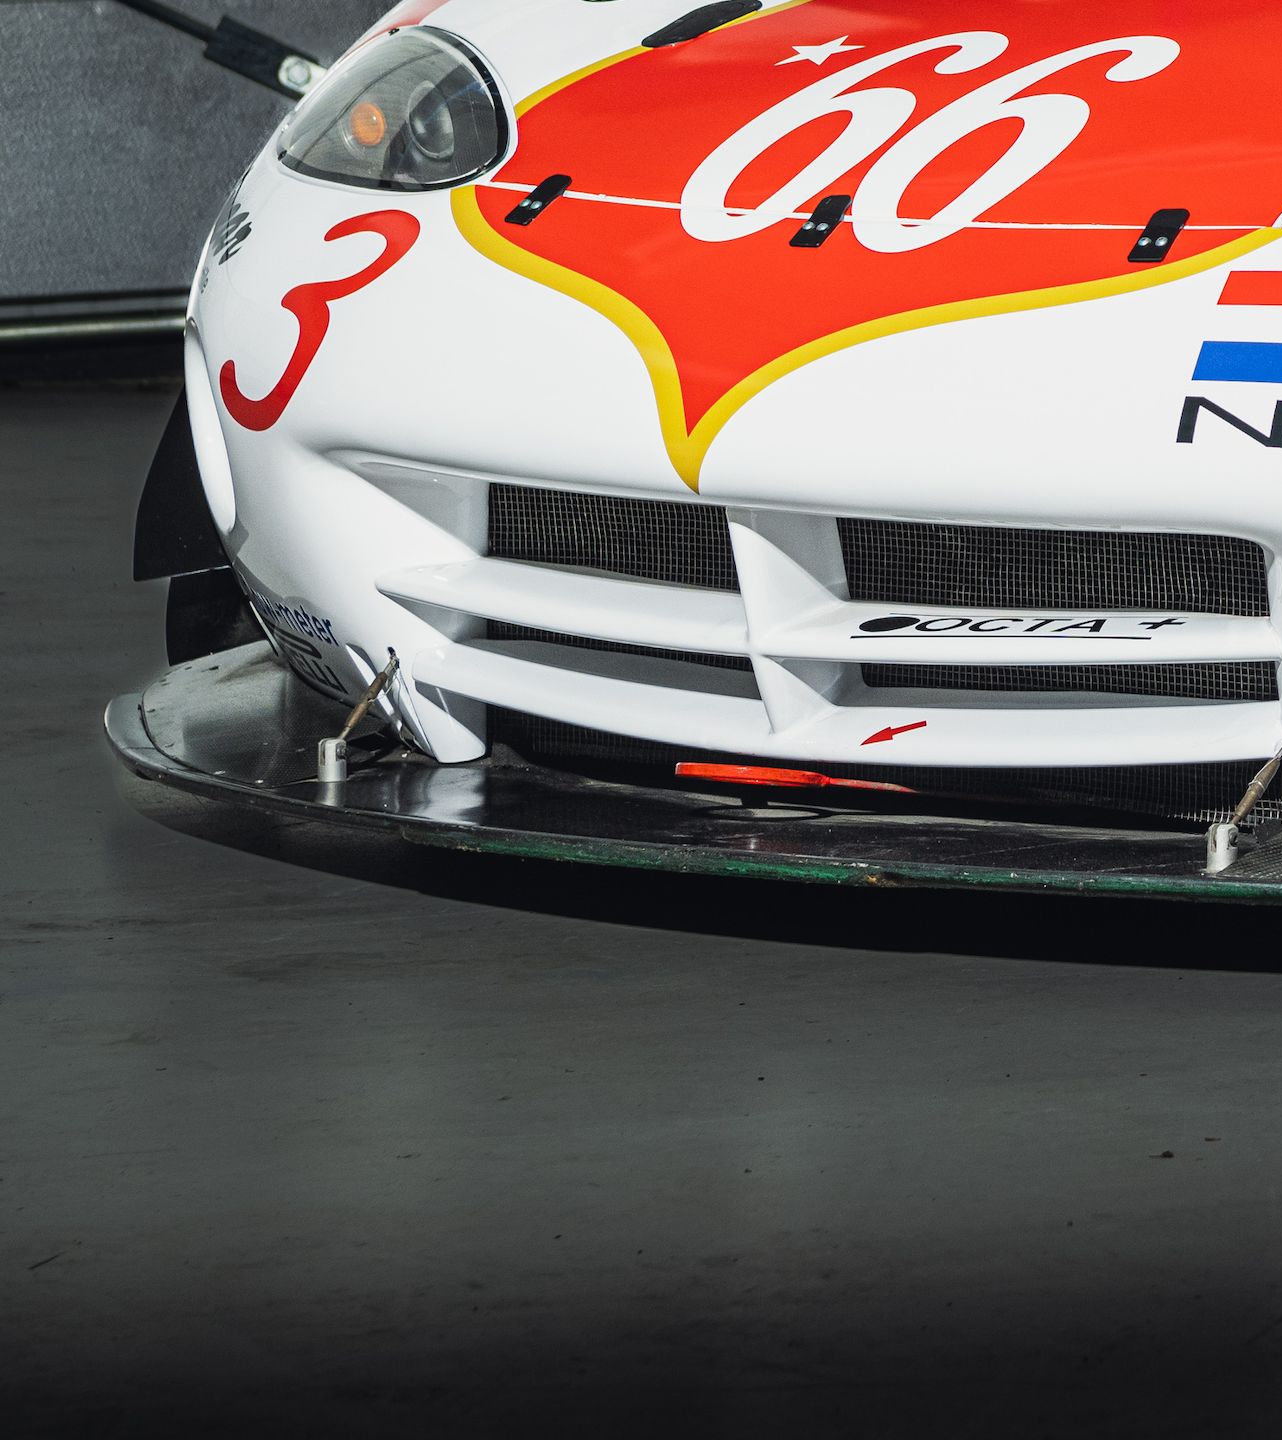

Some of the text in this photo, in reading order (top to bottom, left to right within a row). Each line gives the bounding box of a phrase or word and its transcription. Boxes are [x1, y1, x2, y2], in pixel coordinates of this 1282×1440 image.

[679, 29, 1181, 255] 66
[219, 209, 421, 433] 3
[914, 618, 1108, 633] OCTA
